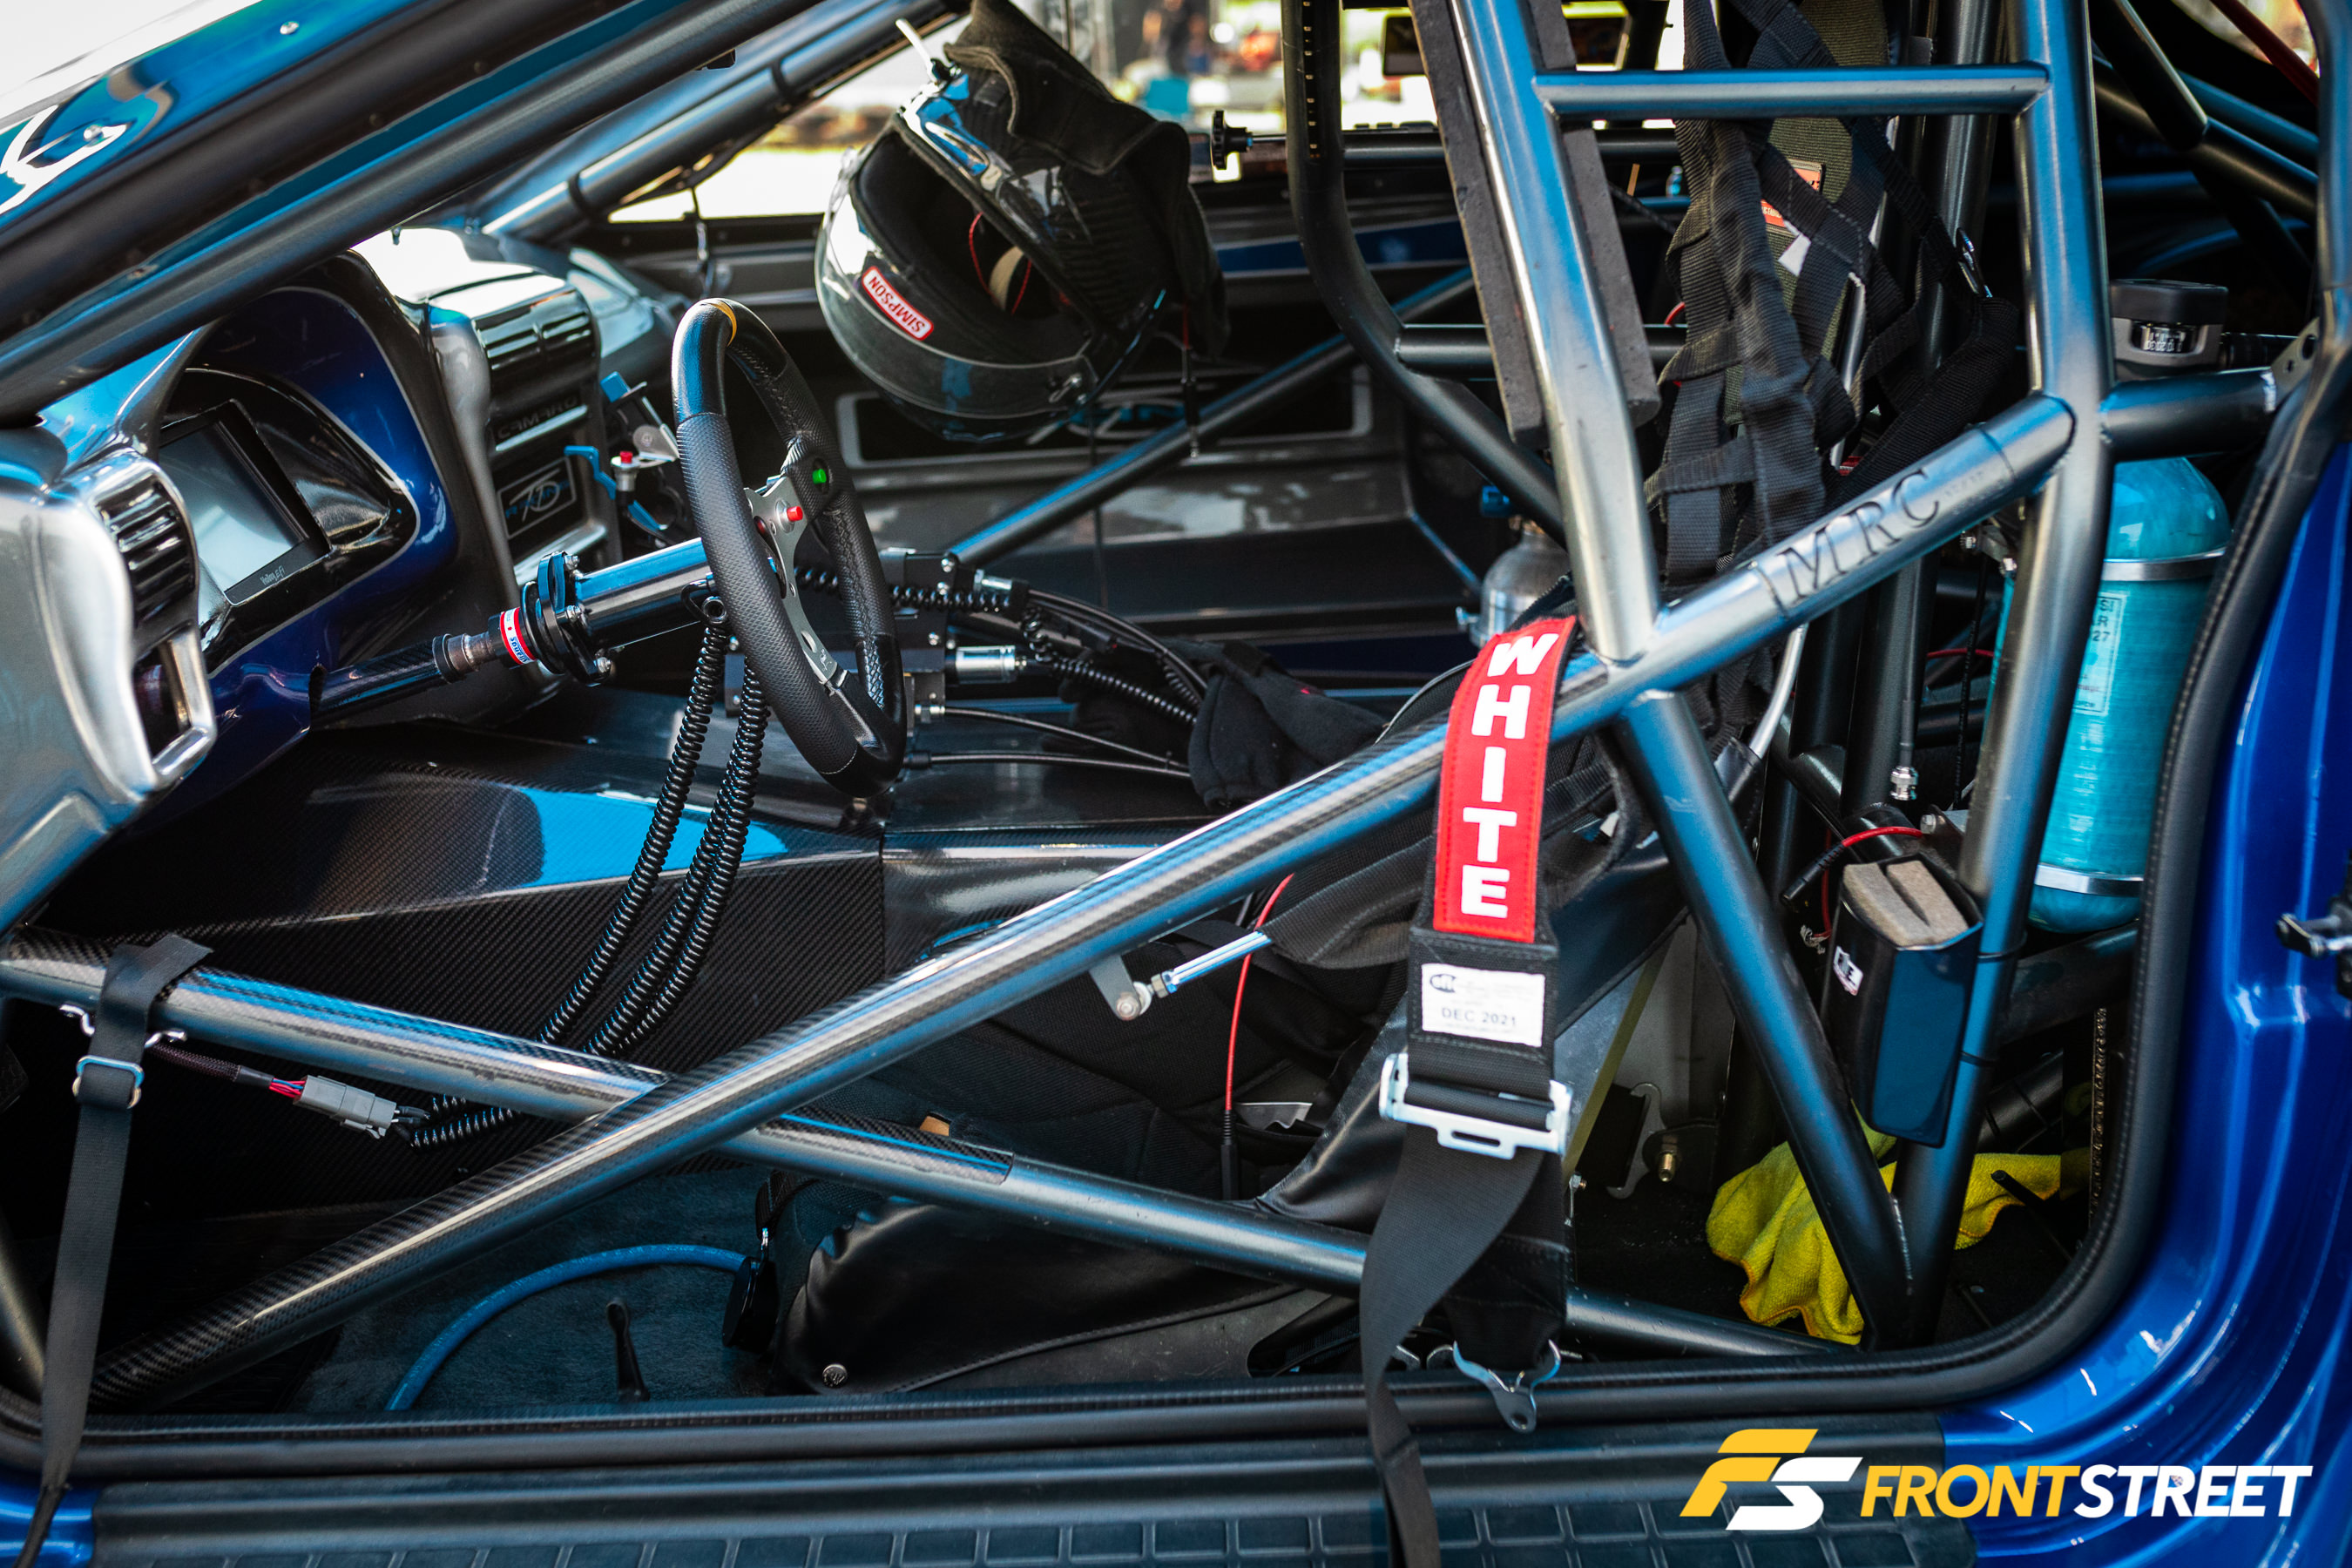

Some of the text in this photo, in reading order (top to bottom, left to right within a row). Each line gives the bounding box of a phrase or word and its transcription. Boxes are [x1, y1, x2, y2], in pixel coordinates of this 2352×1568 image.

[868, 276, 925, 332] SIMPSON
[1775, 468, 1939, 601] MRC
[1461, 633, 1558, 919] WHITE
[1441, 1007, 1517, 1027] DEC 2021
